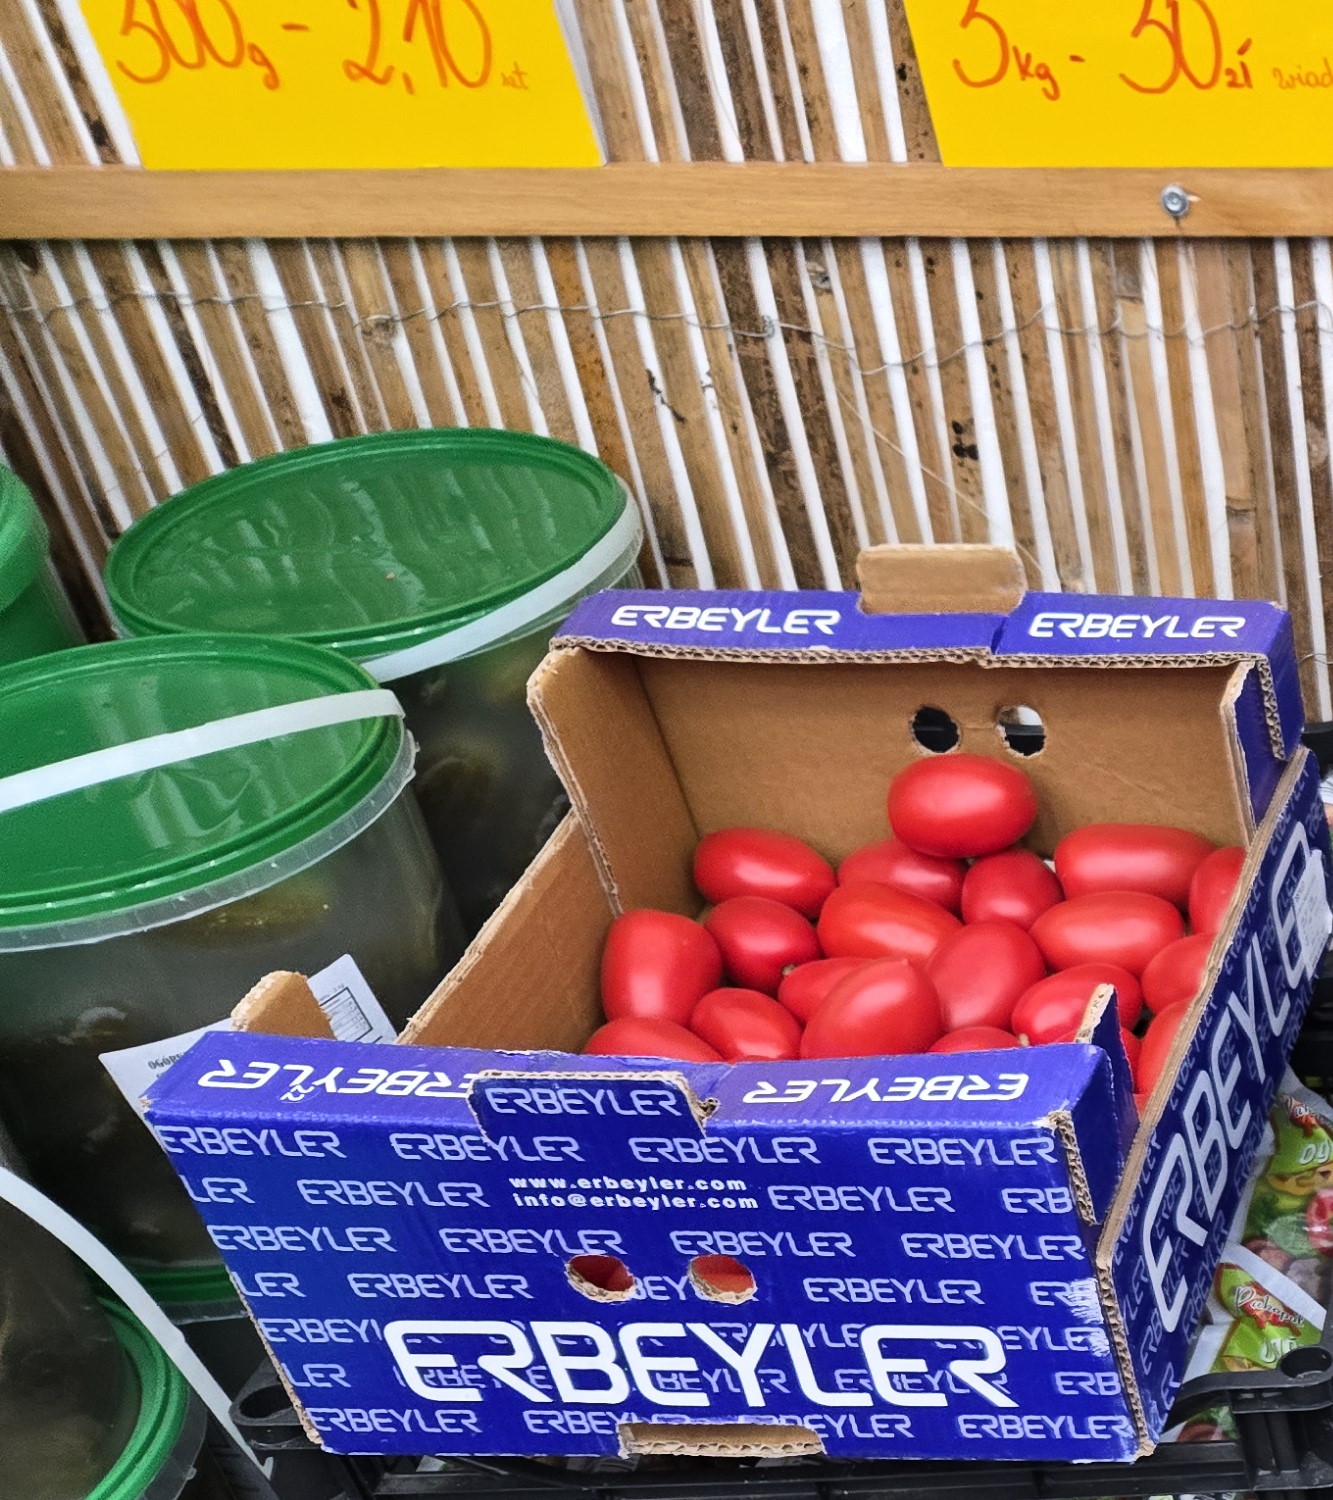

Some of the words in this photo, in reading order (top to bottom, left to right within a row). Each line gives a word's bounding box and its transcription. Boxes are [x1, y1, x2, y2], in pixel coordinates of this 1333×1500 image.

[610, 604, 841, 637] ERBEYLER
[1028, 611, 1247, 640] ERBEYLER
[484, 1086, 682, 1118] ERBEYLER
[742, 1073, 1030, 1104] ERBEYLER
[158, 1125, 347, 1159] ERBEYLER
[391, 1132, 586, 1163] ERBEYLER
[628, 1135, 822, 1165] ERBEYLER
[869, 1136, 1058, 1166] ERBEYLER
[300, 1178, 490, 1208] ERBEYLER
[508, 1175, 748, 1193] www.erbeyler.com
[513, 1191, 758, 1211] info@erbeyler.com
[766, 1184, 956, 1214] ERBEYLER
[206, 1224, 397, 1253] ERBEYLER
[442, 1227, 627, 1255] ERBEYLER
[669, 1230, 856, 1258] ERBEYLER
[900, 1232, 1086, 1261] ERBEYLER
[346, 1272, 535, 1300] ERBEYLER
[803, 1278, 985, 1306] ERBEYLER
[384, 1319, 1021, 1408] ERBEYLER
[306, 1407, 483, 1435] ERBEYLER
[956, 1413, 1131, 1440] ERBEYLER
